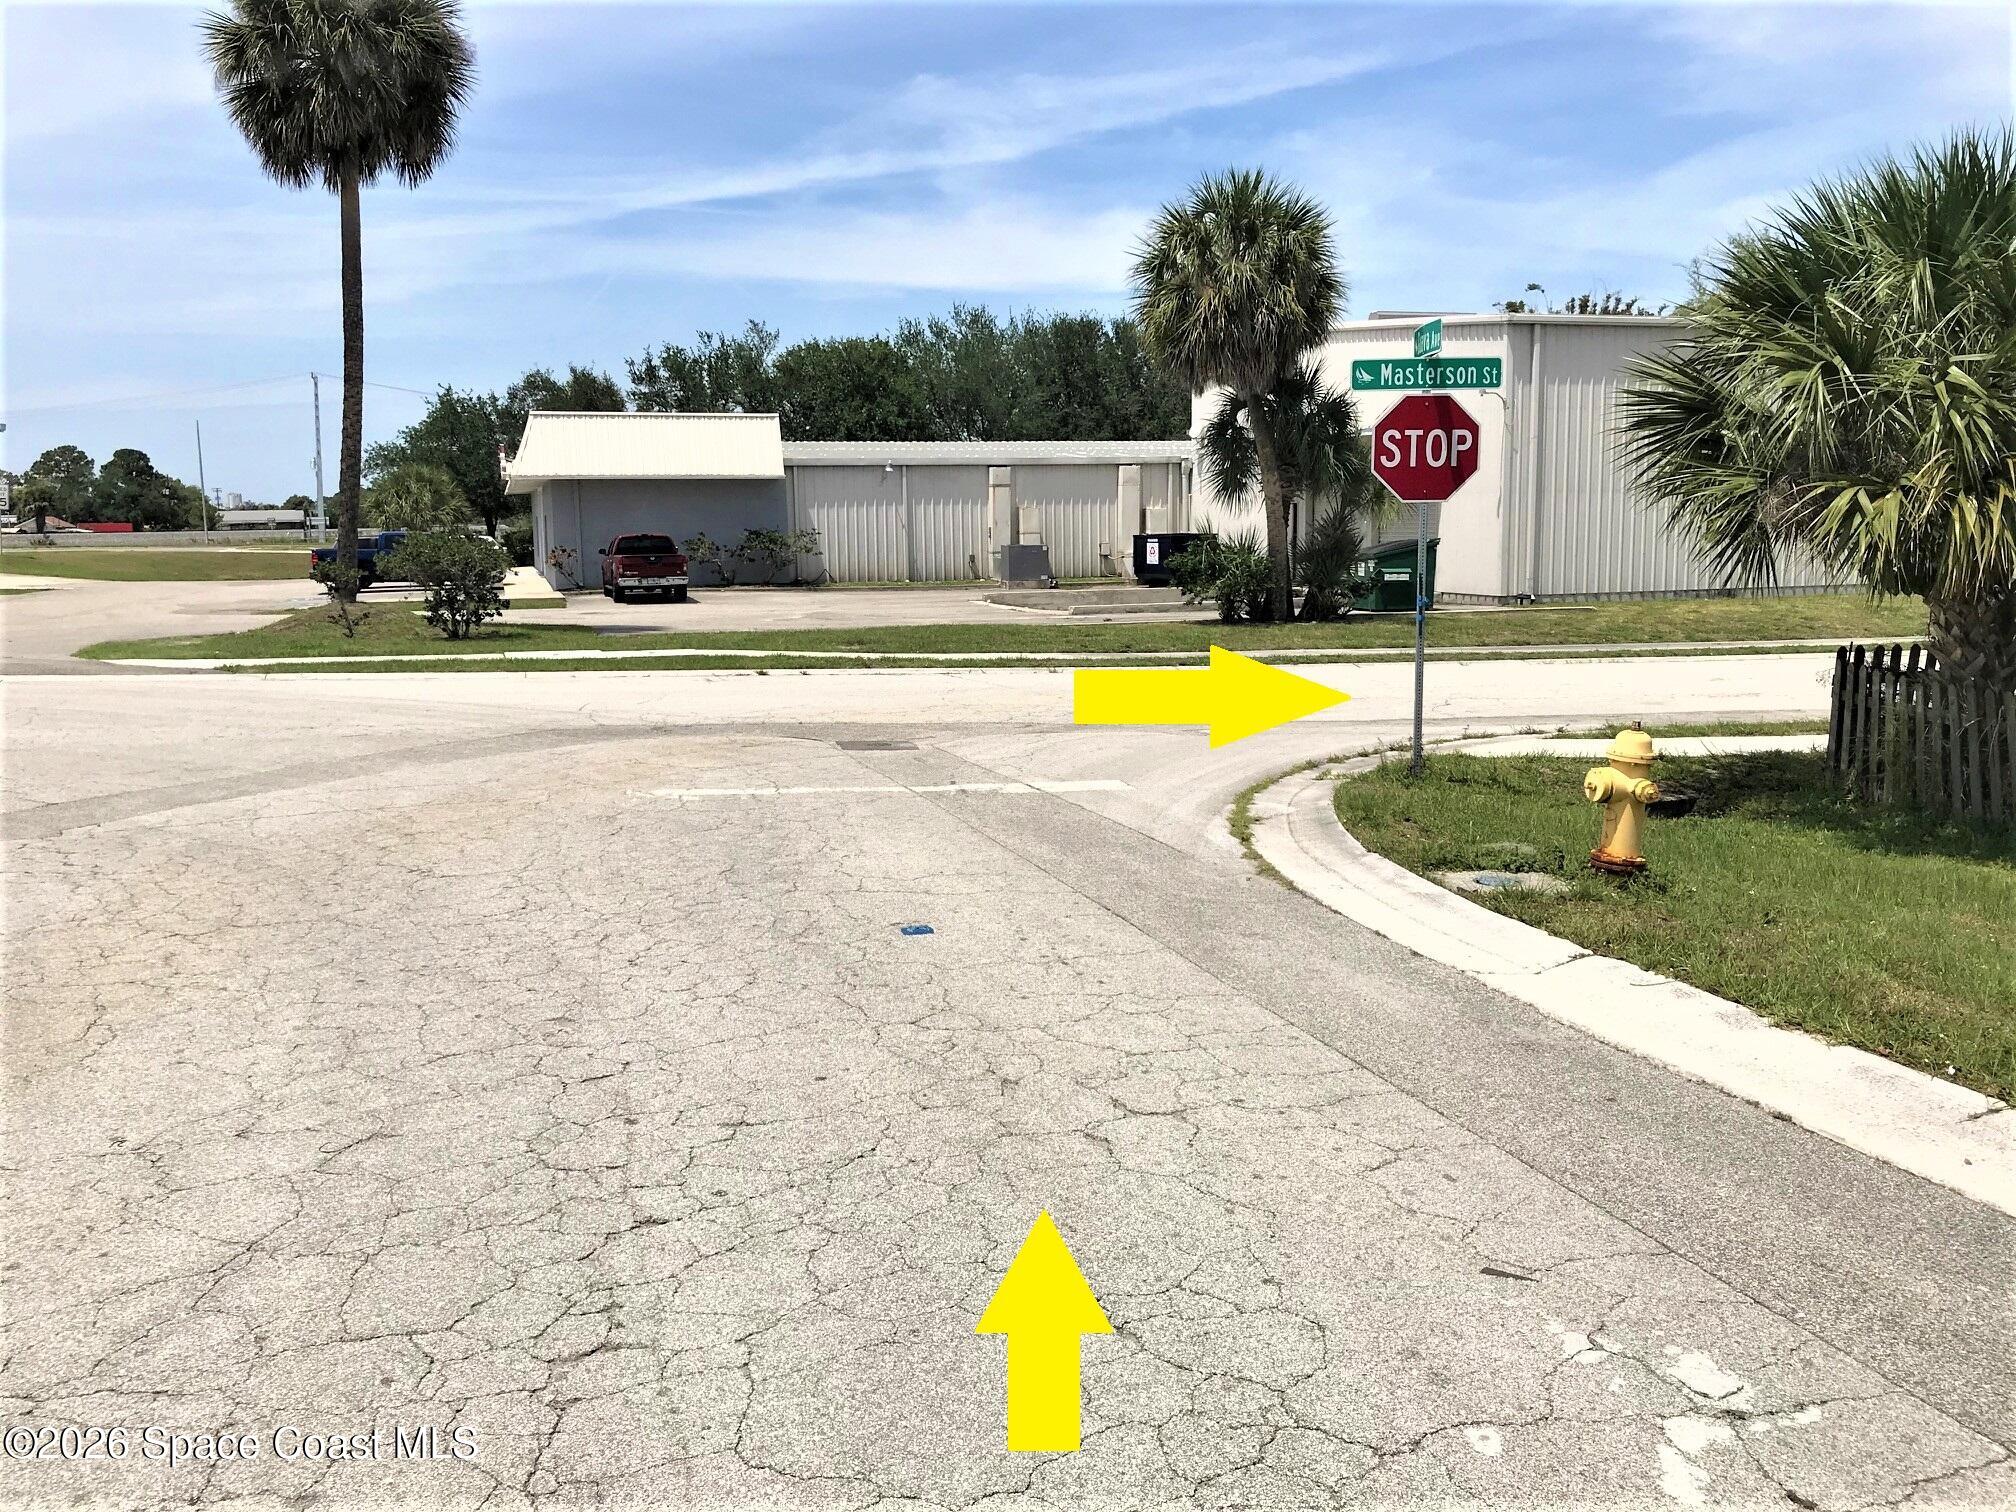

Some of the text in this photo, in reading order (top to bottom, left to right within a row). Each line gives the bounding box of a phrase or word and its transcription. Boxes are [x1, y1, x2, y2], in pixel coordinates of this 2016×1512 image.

[1381, 363, 1497, 385] Masterson St
[1381, 429, 1472, 467] STOP
